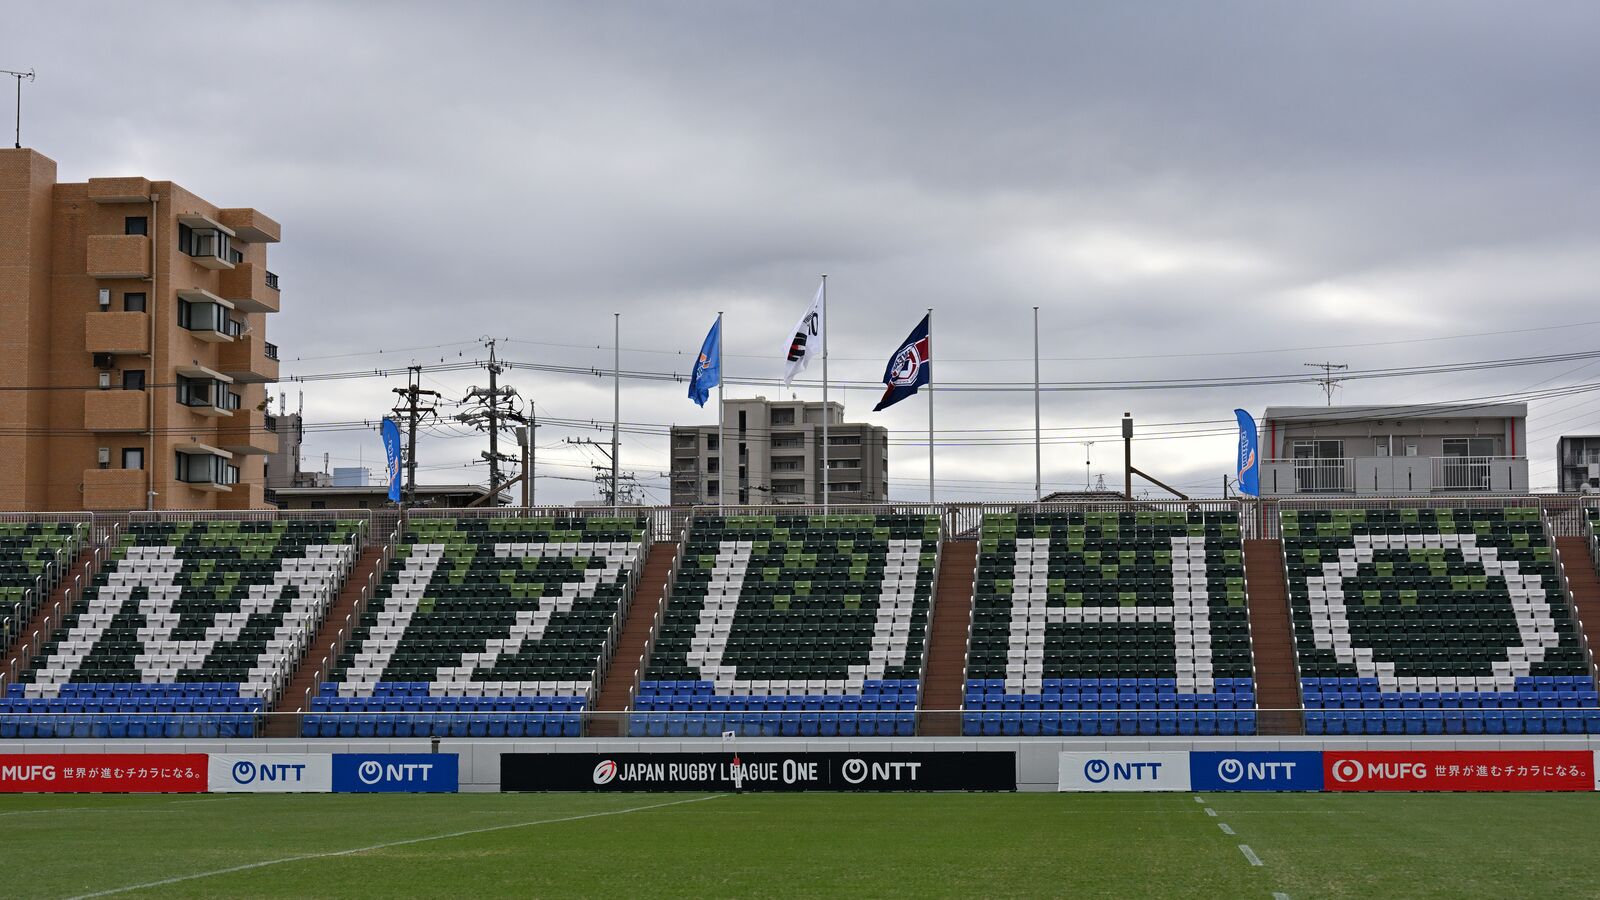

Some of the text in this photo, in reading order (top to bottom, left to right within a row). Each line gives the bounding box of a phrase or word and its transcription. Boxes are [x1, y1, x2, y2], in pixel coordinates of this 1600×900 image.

[1, 765, 200, 781] MUFG 世界が進むチカラになる。
[259, 764, 306, 782] NTT
[386, 764, 433, 782] NTT
[618, 762, 665, 782] JAPAN
[669, 762, 717, 782] RUGBY
[720, 762, 779, 781] LEAGUE
[782, 759, 818, 782] ONE
[871, 762, 922, 781] NTT
[1113, 763, 1163, 780] NTT
[1247, 763, 1297, 780] NTT
[1367, 762, 1586, 779] MUFG 世界が進むチカラになる。
